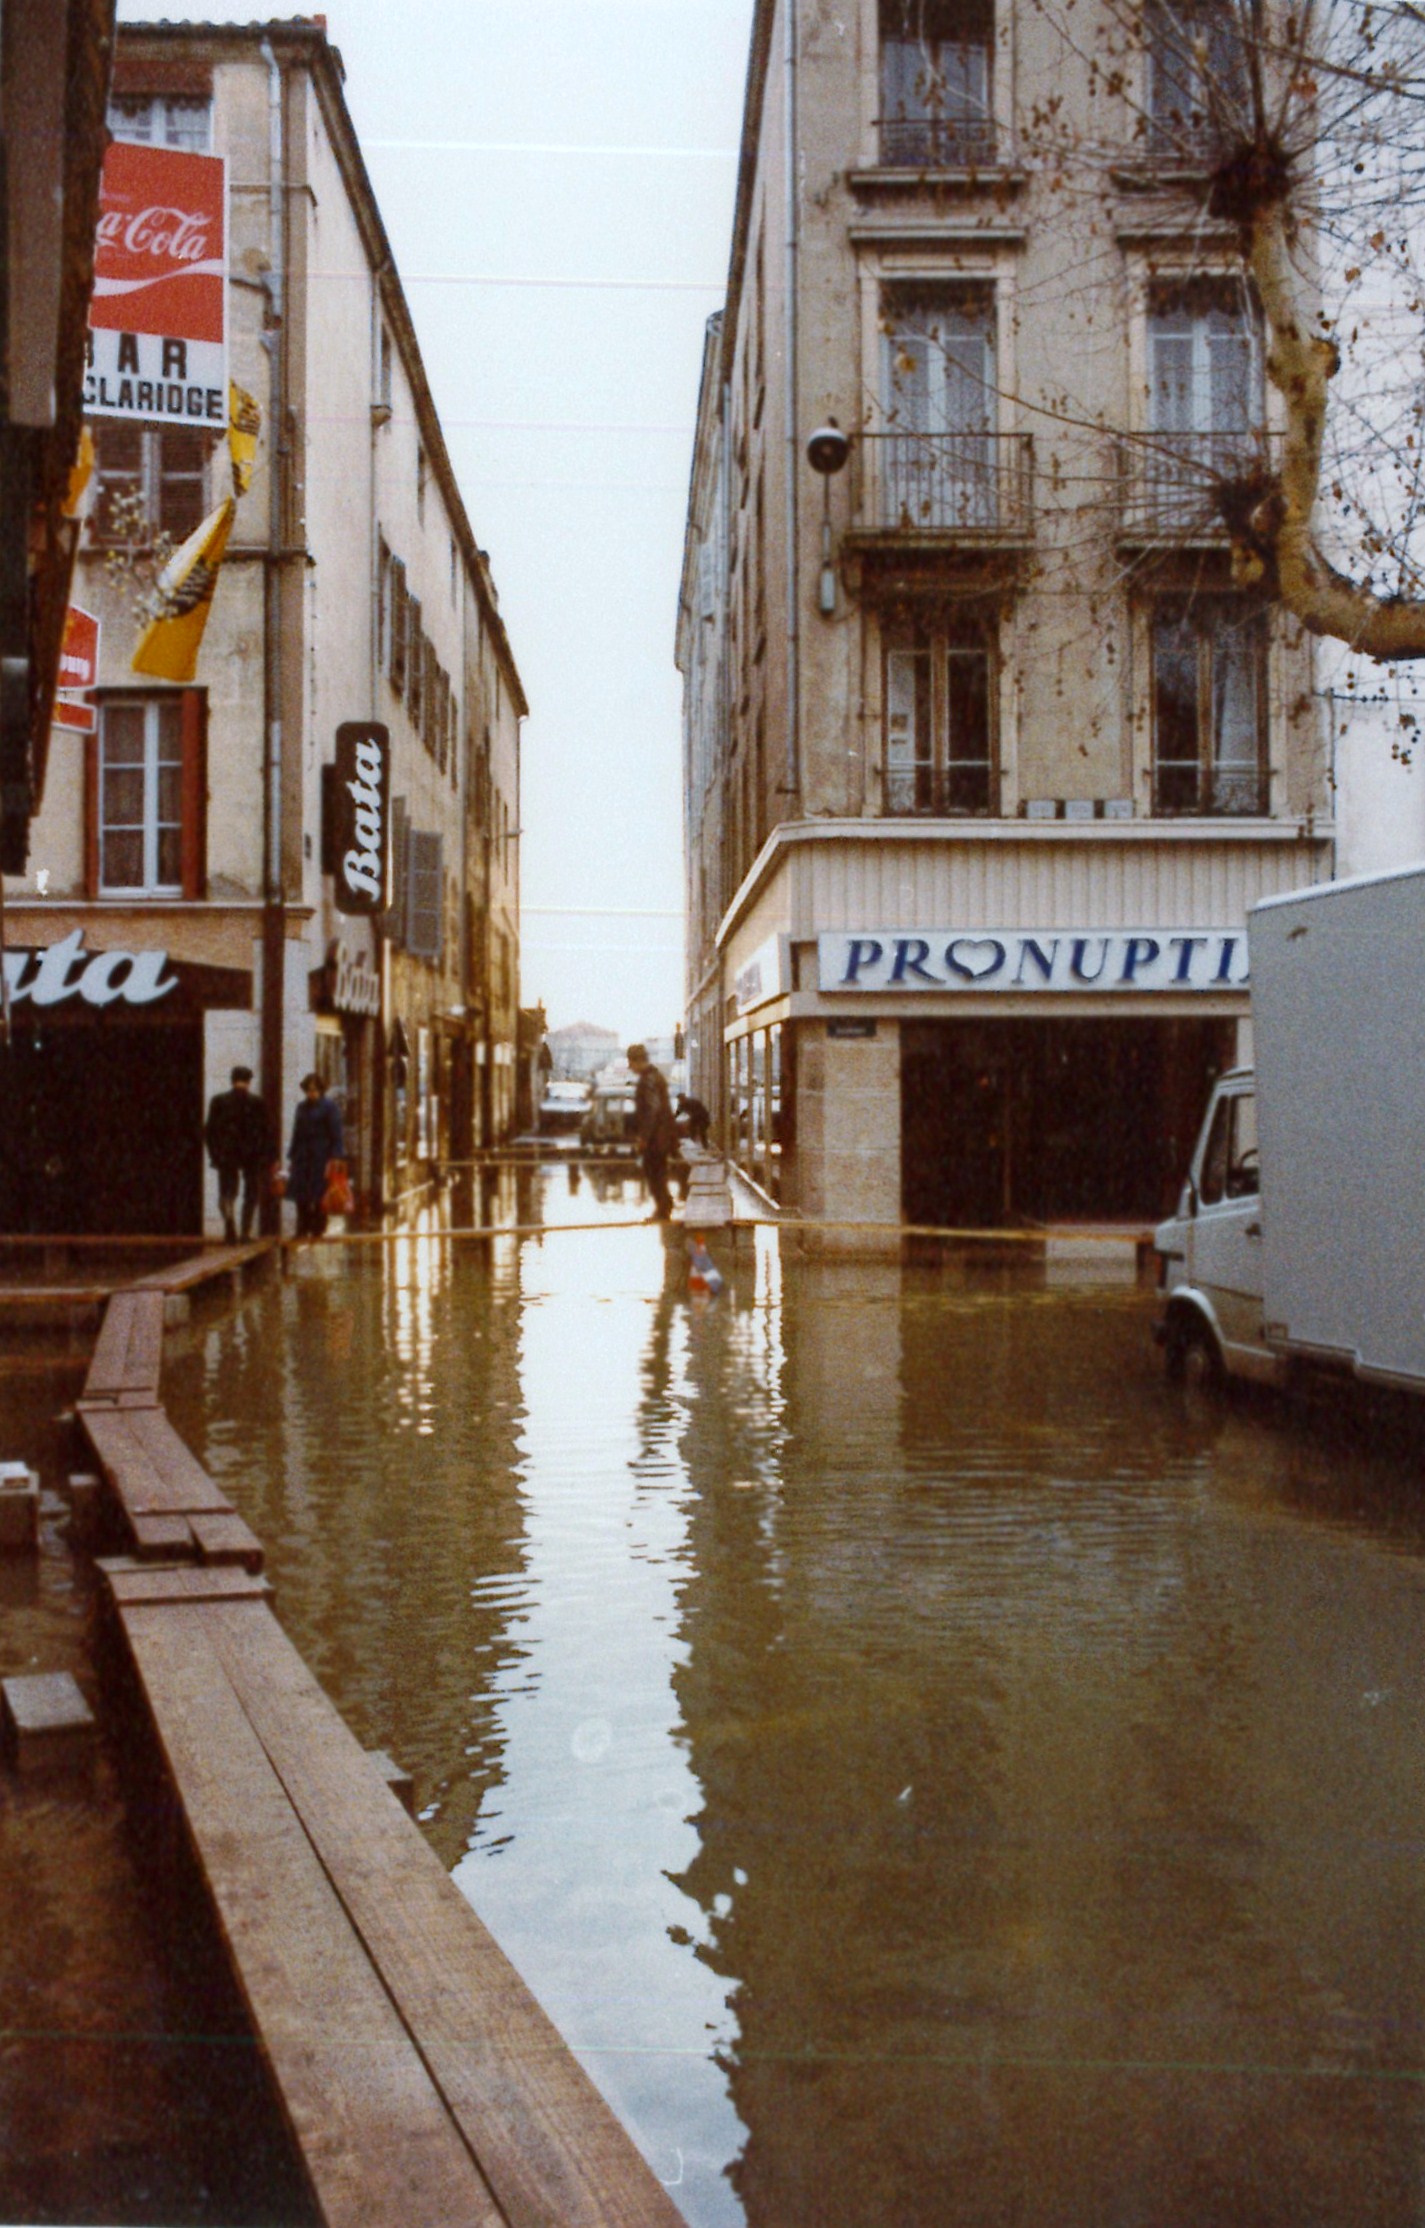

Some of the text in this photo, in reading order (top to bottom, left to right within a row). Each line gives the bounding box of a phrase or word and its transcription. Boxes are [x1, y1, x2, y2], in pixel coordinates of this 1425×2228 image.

[82, 375, 224, 419] CLARIDGE
[343, 738, 382, 902] Bata
[839, 937, 1249, 985] PRONUPTI
